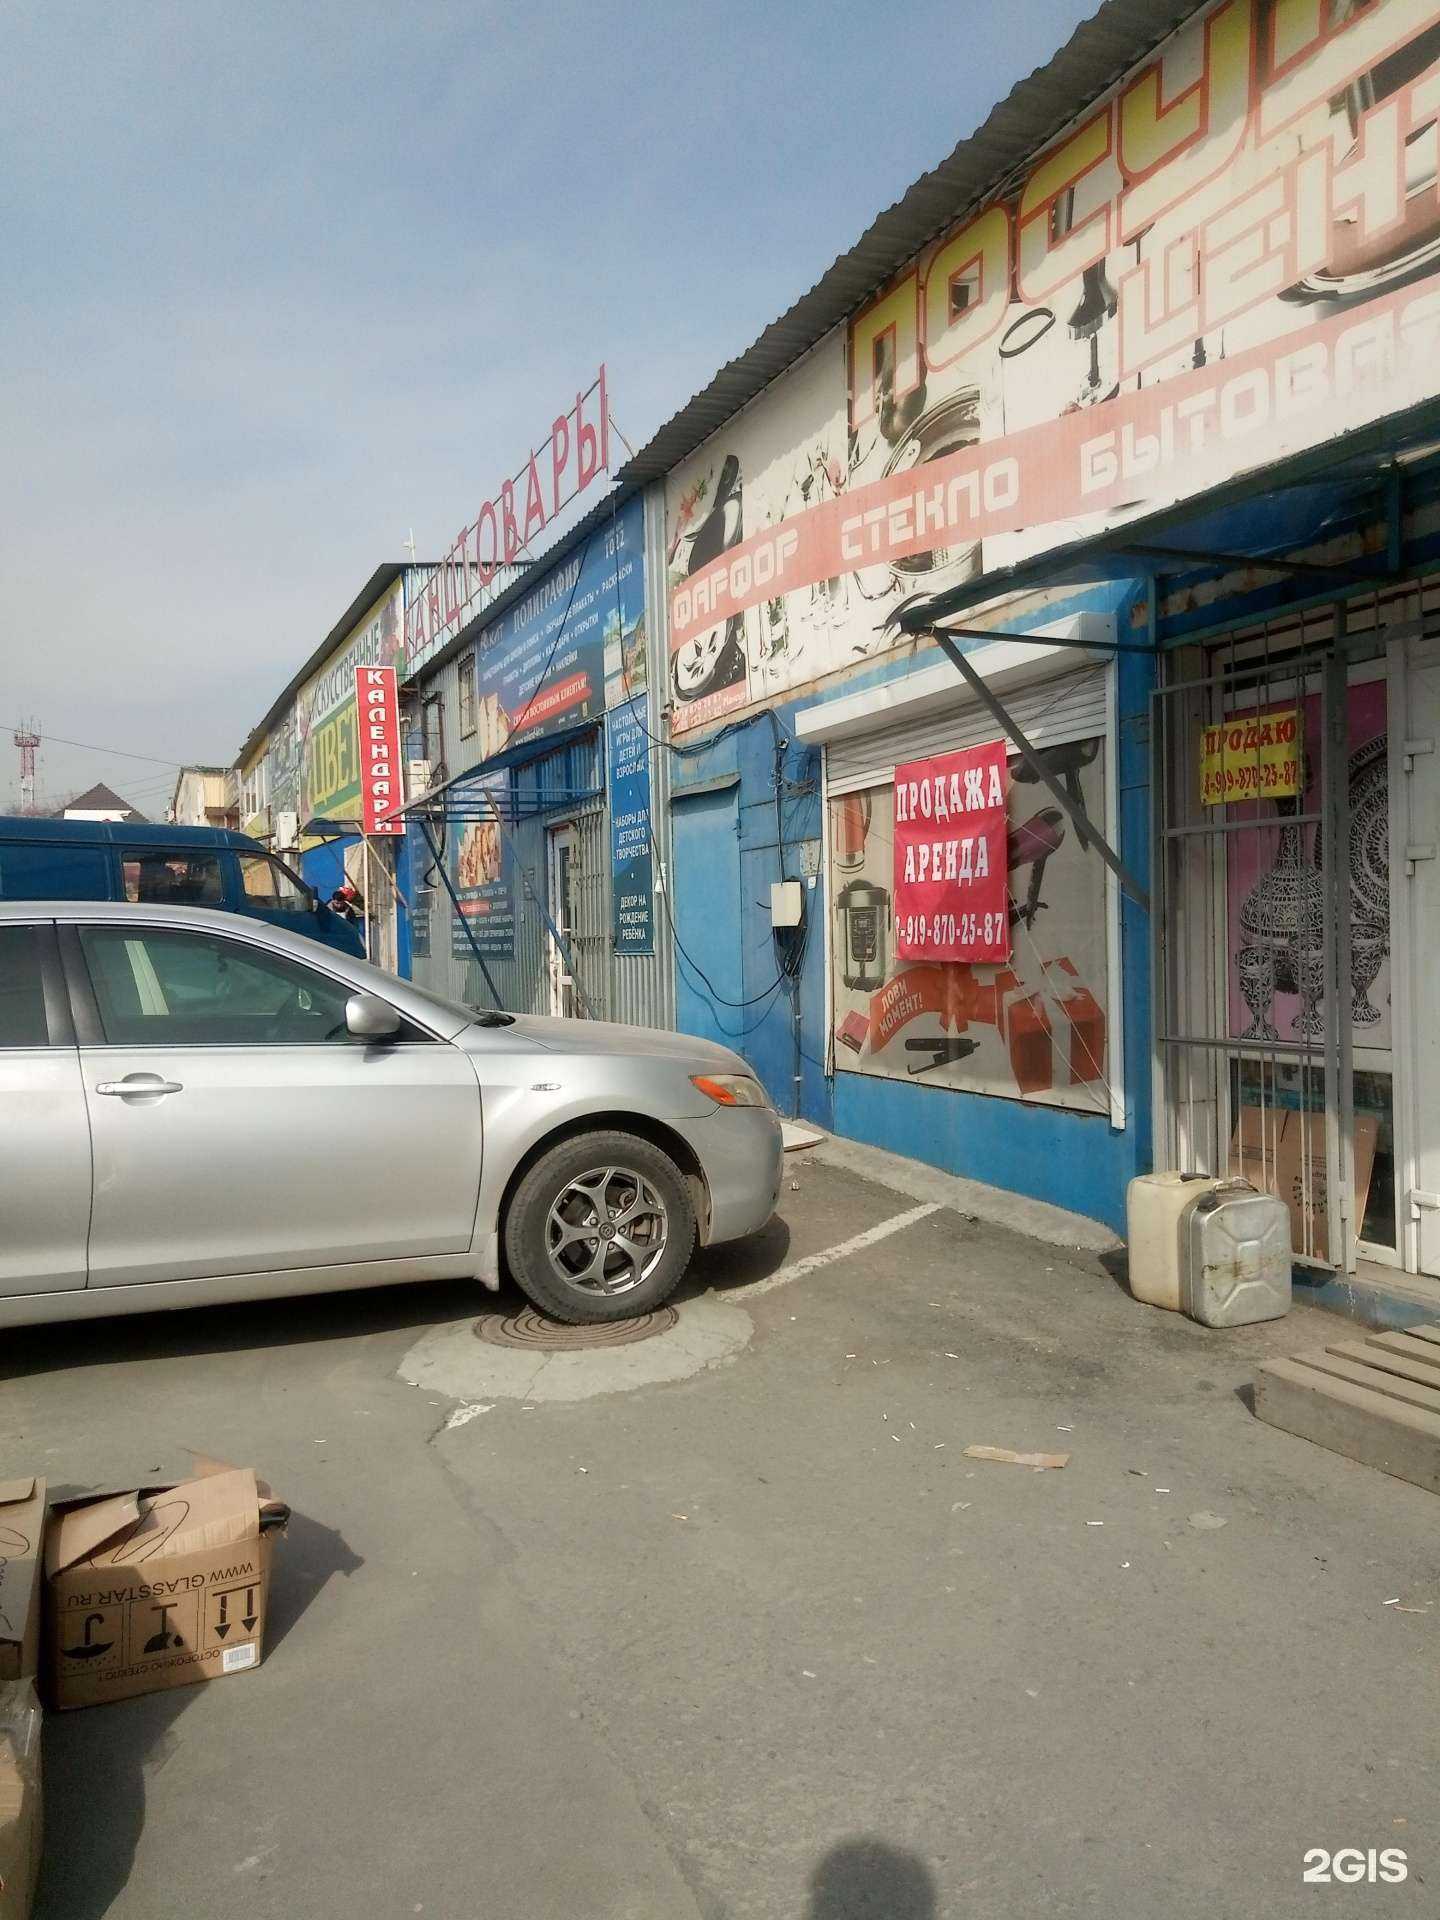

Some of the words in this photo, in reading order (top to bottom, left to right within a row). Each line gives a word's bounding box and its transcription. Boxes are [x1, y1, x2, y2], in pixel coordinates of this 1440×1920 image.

[674, 528, 798, 630] ФАРФОР
[841, 457, 1019, 560] СТЕКЛО
[616, 732, 631, 746] ИГРЫ
[1205, 719, 1296, 754] ПРОДАЮ
[312, 700, 358, 806] ЦВЕТ
[367, 670, 392, 832] КАЛЕНДАРИ
[618, 743, 637, 764] ДЕТЕЙ
[616, 761, 645, 780] ВЗРОСЛЫХ
[896, 764, 1004, 824] ПРОДАЖА
[615, 811, 636, 828] НАБОРЫ
[618, 826, 646, 845] ДЕТСКОГО
[615, 844, 650, 861] ТВОРЧЕСТВА
[904, 836, 989, 888] АРЕНДА
[620, 895, 638, 911] ДЕКОР
[638, 894, 647, 907] НА
[619, 910, 649, 926] РОЖДЕНИЕ
[622, 925, 646, 940] РЕБЁНКА
[882, 978, 907, 1013] ЛОВИ
[879, 991, 923, 1037] МОМЕНТ!
